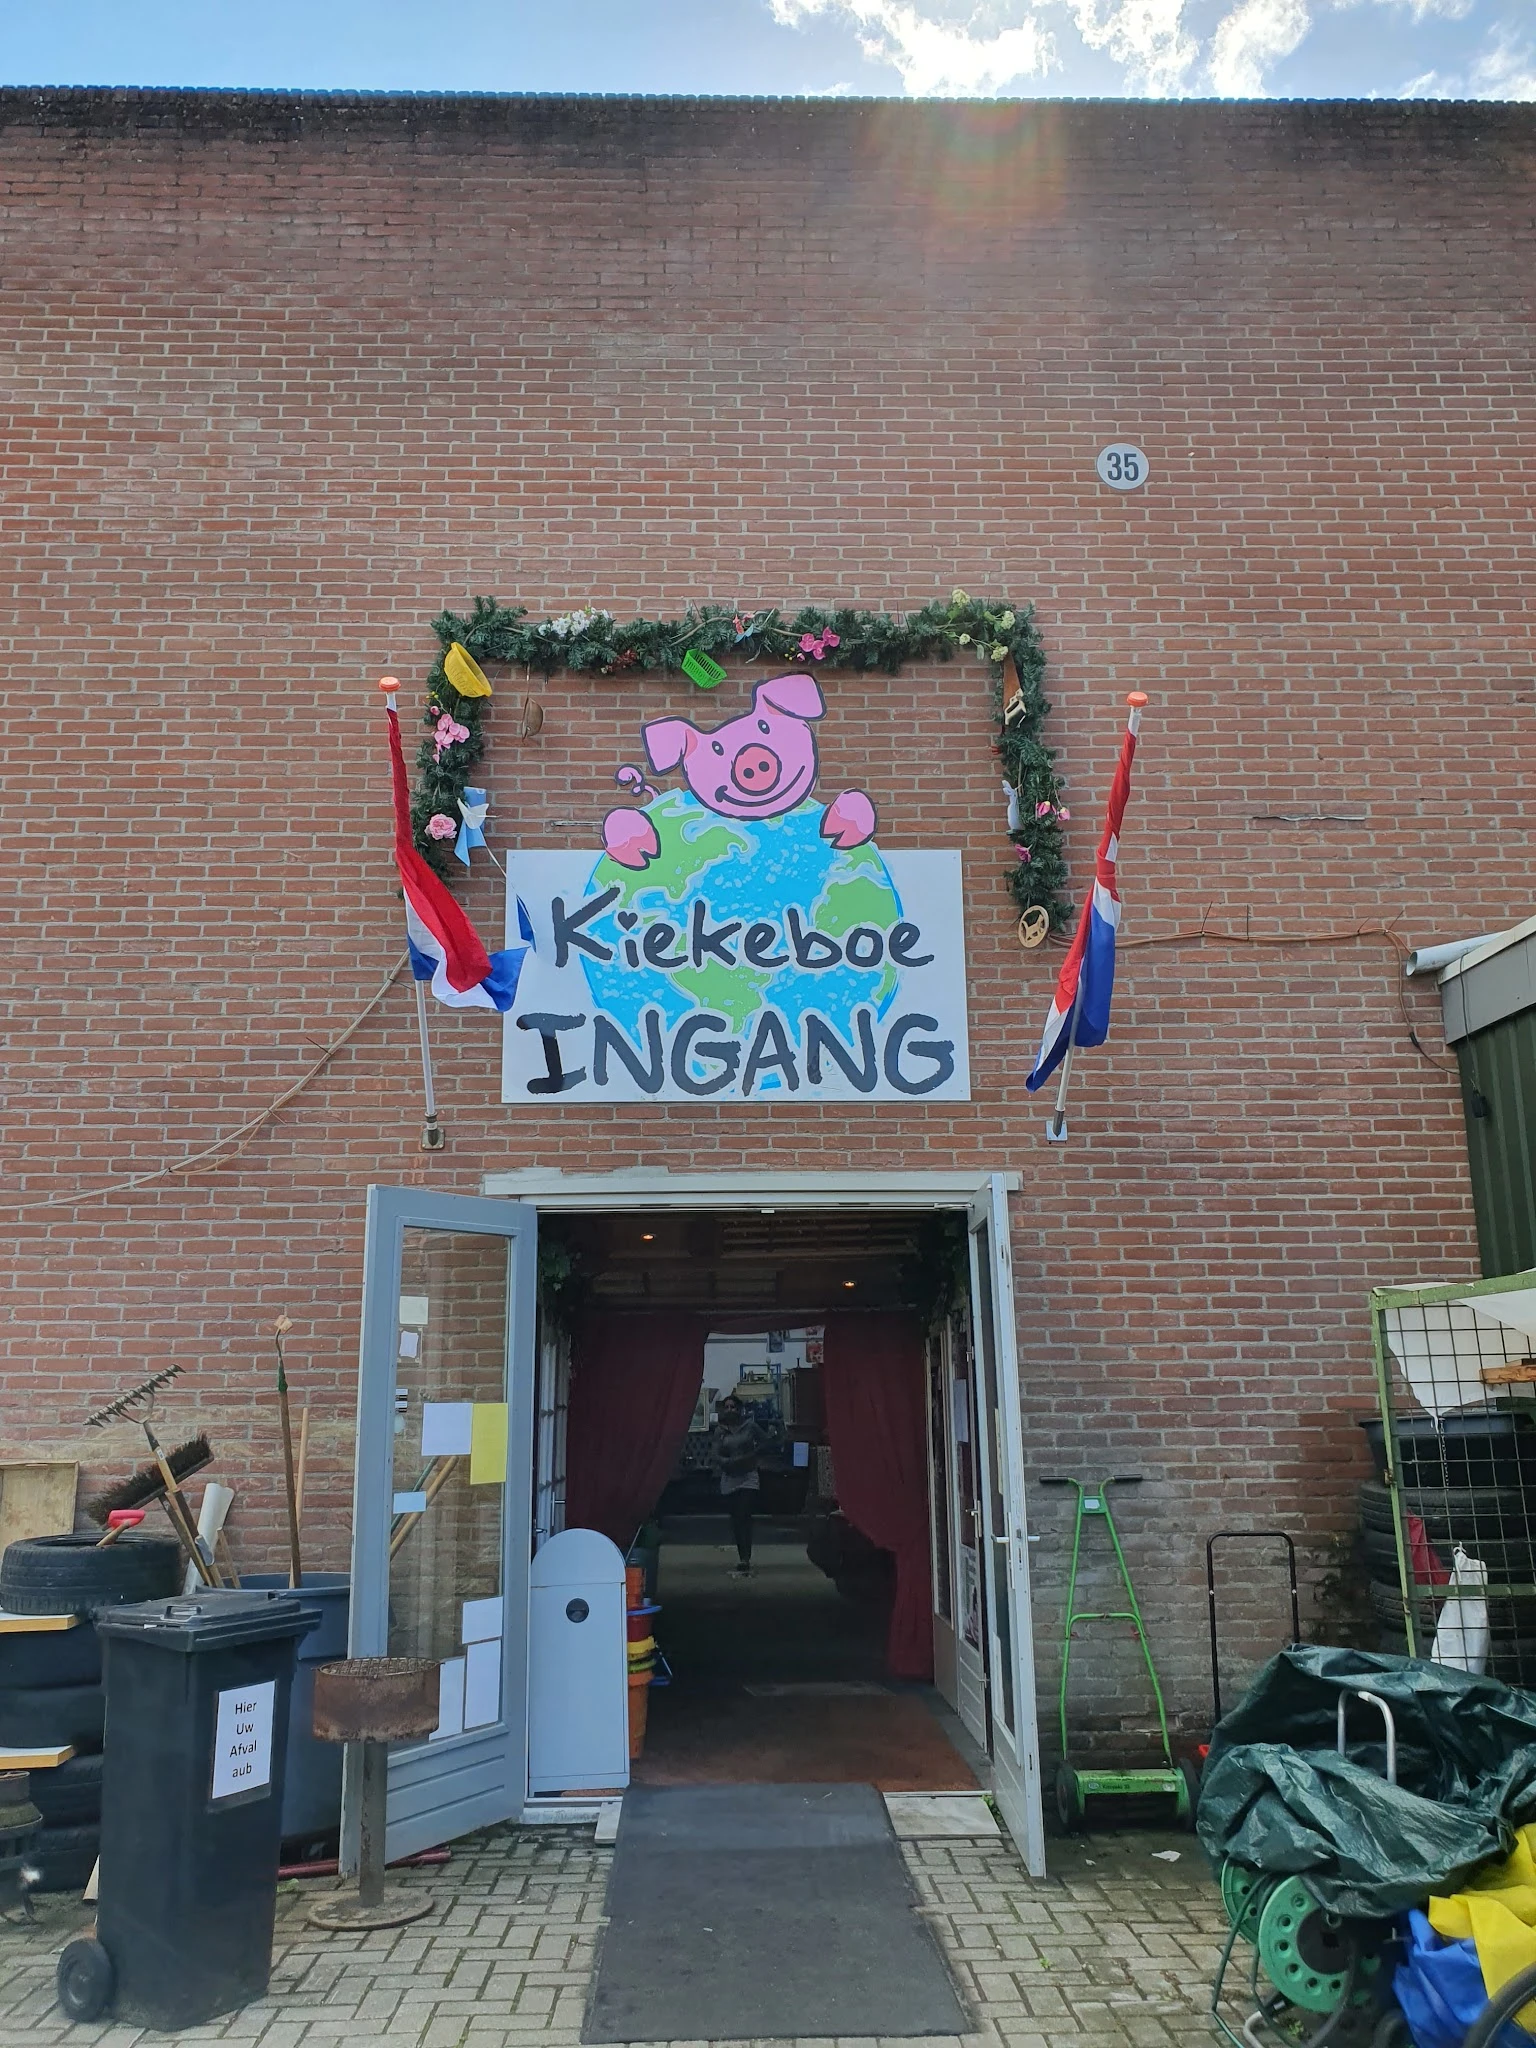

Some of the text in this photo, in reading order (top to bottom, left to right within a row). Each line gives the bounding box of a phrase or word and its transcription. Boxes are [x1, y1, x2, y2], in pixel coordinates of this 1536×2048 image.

[1106, 452, 1139, 481] 35
[551, 887, 935, 968] Kiekeboe
[516, 1008, 955, 1097] INGANG
[235, 1701, 257, 1715] Hier
[236, 1722, 254, 1735] Uw
[229, 1740, 257, 1757] Afval
[232, 1762, 252, 1778] aub
